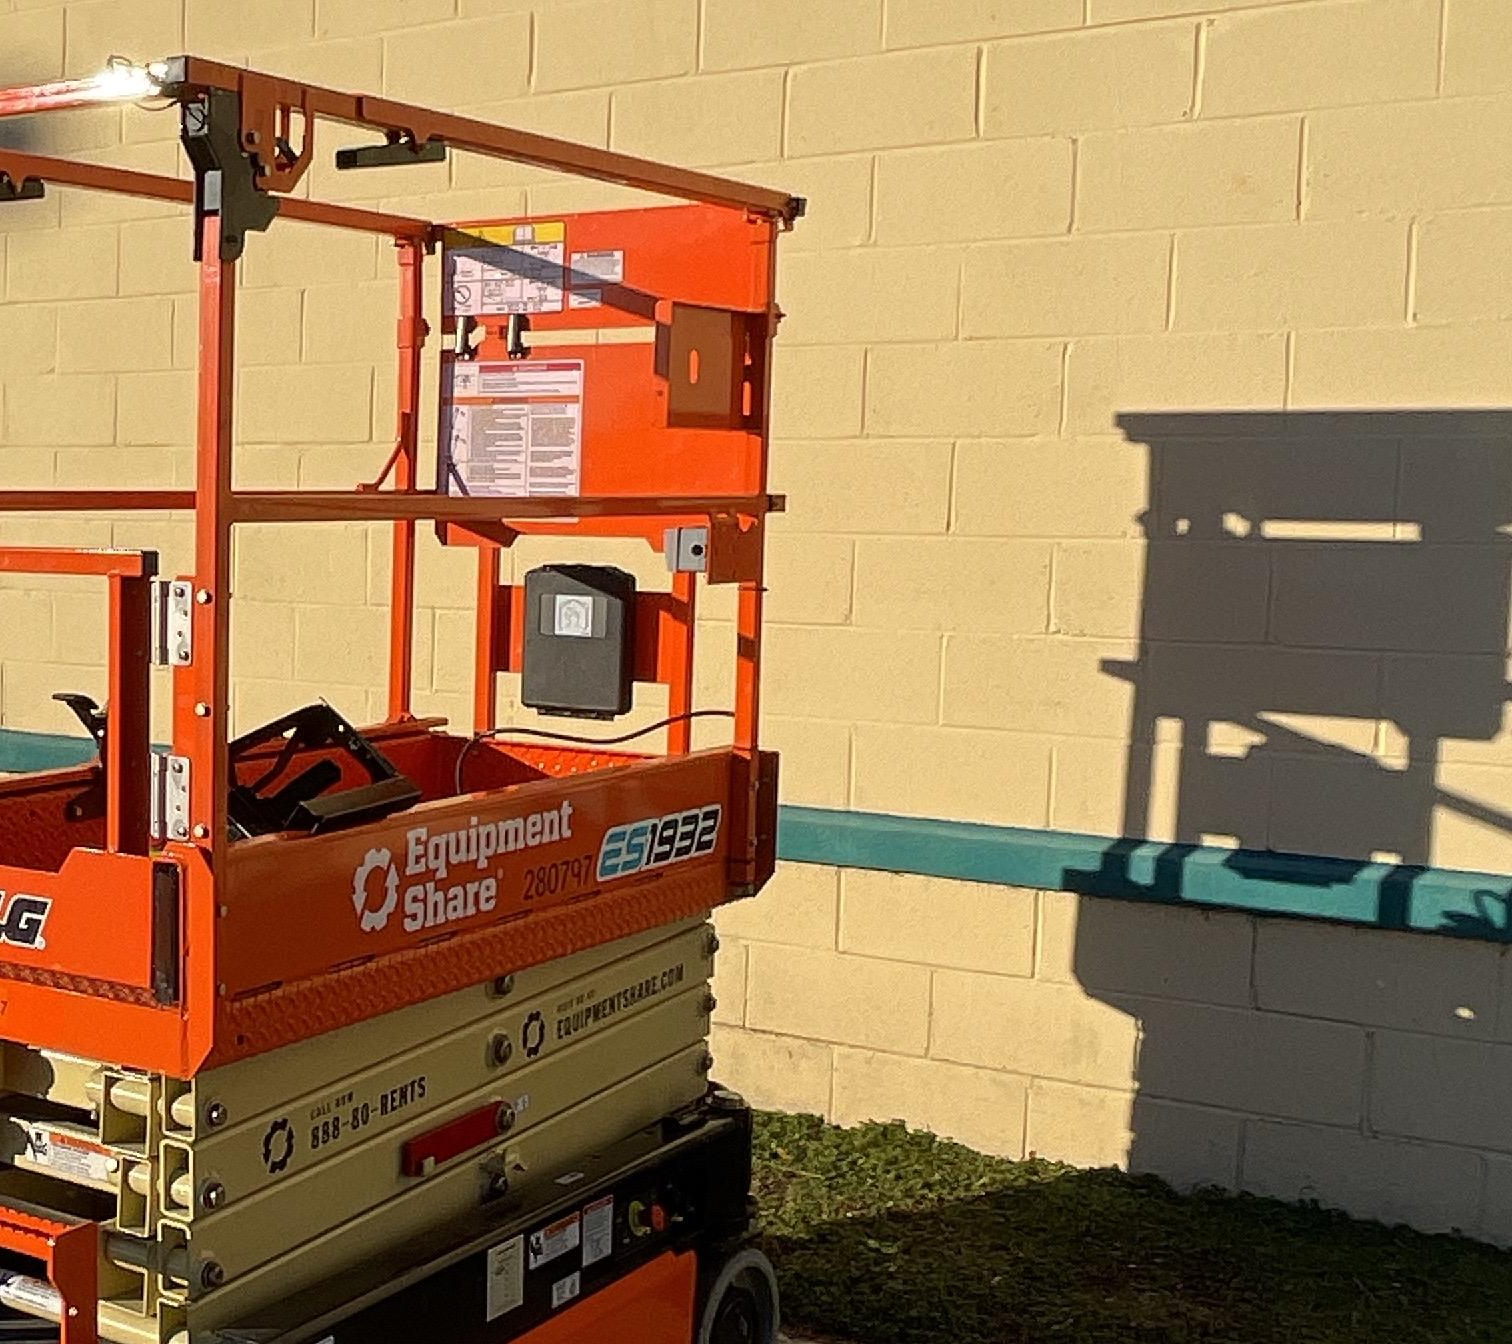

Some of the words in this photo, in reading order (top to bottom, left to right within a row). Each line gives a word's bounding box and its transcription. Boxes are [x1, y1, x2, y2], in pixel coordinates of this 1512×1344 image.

[406, 800, 574, 880] Equipment
[596, 804, 721, 881] ES1932
[403, 877, 498, 932] Share
[523, 854, 593, 901] 280797
